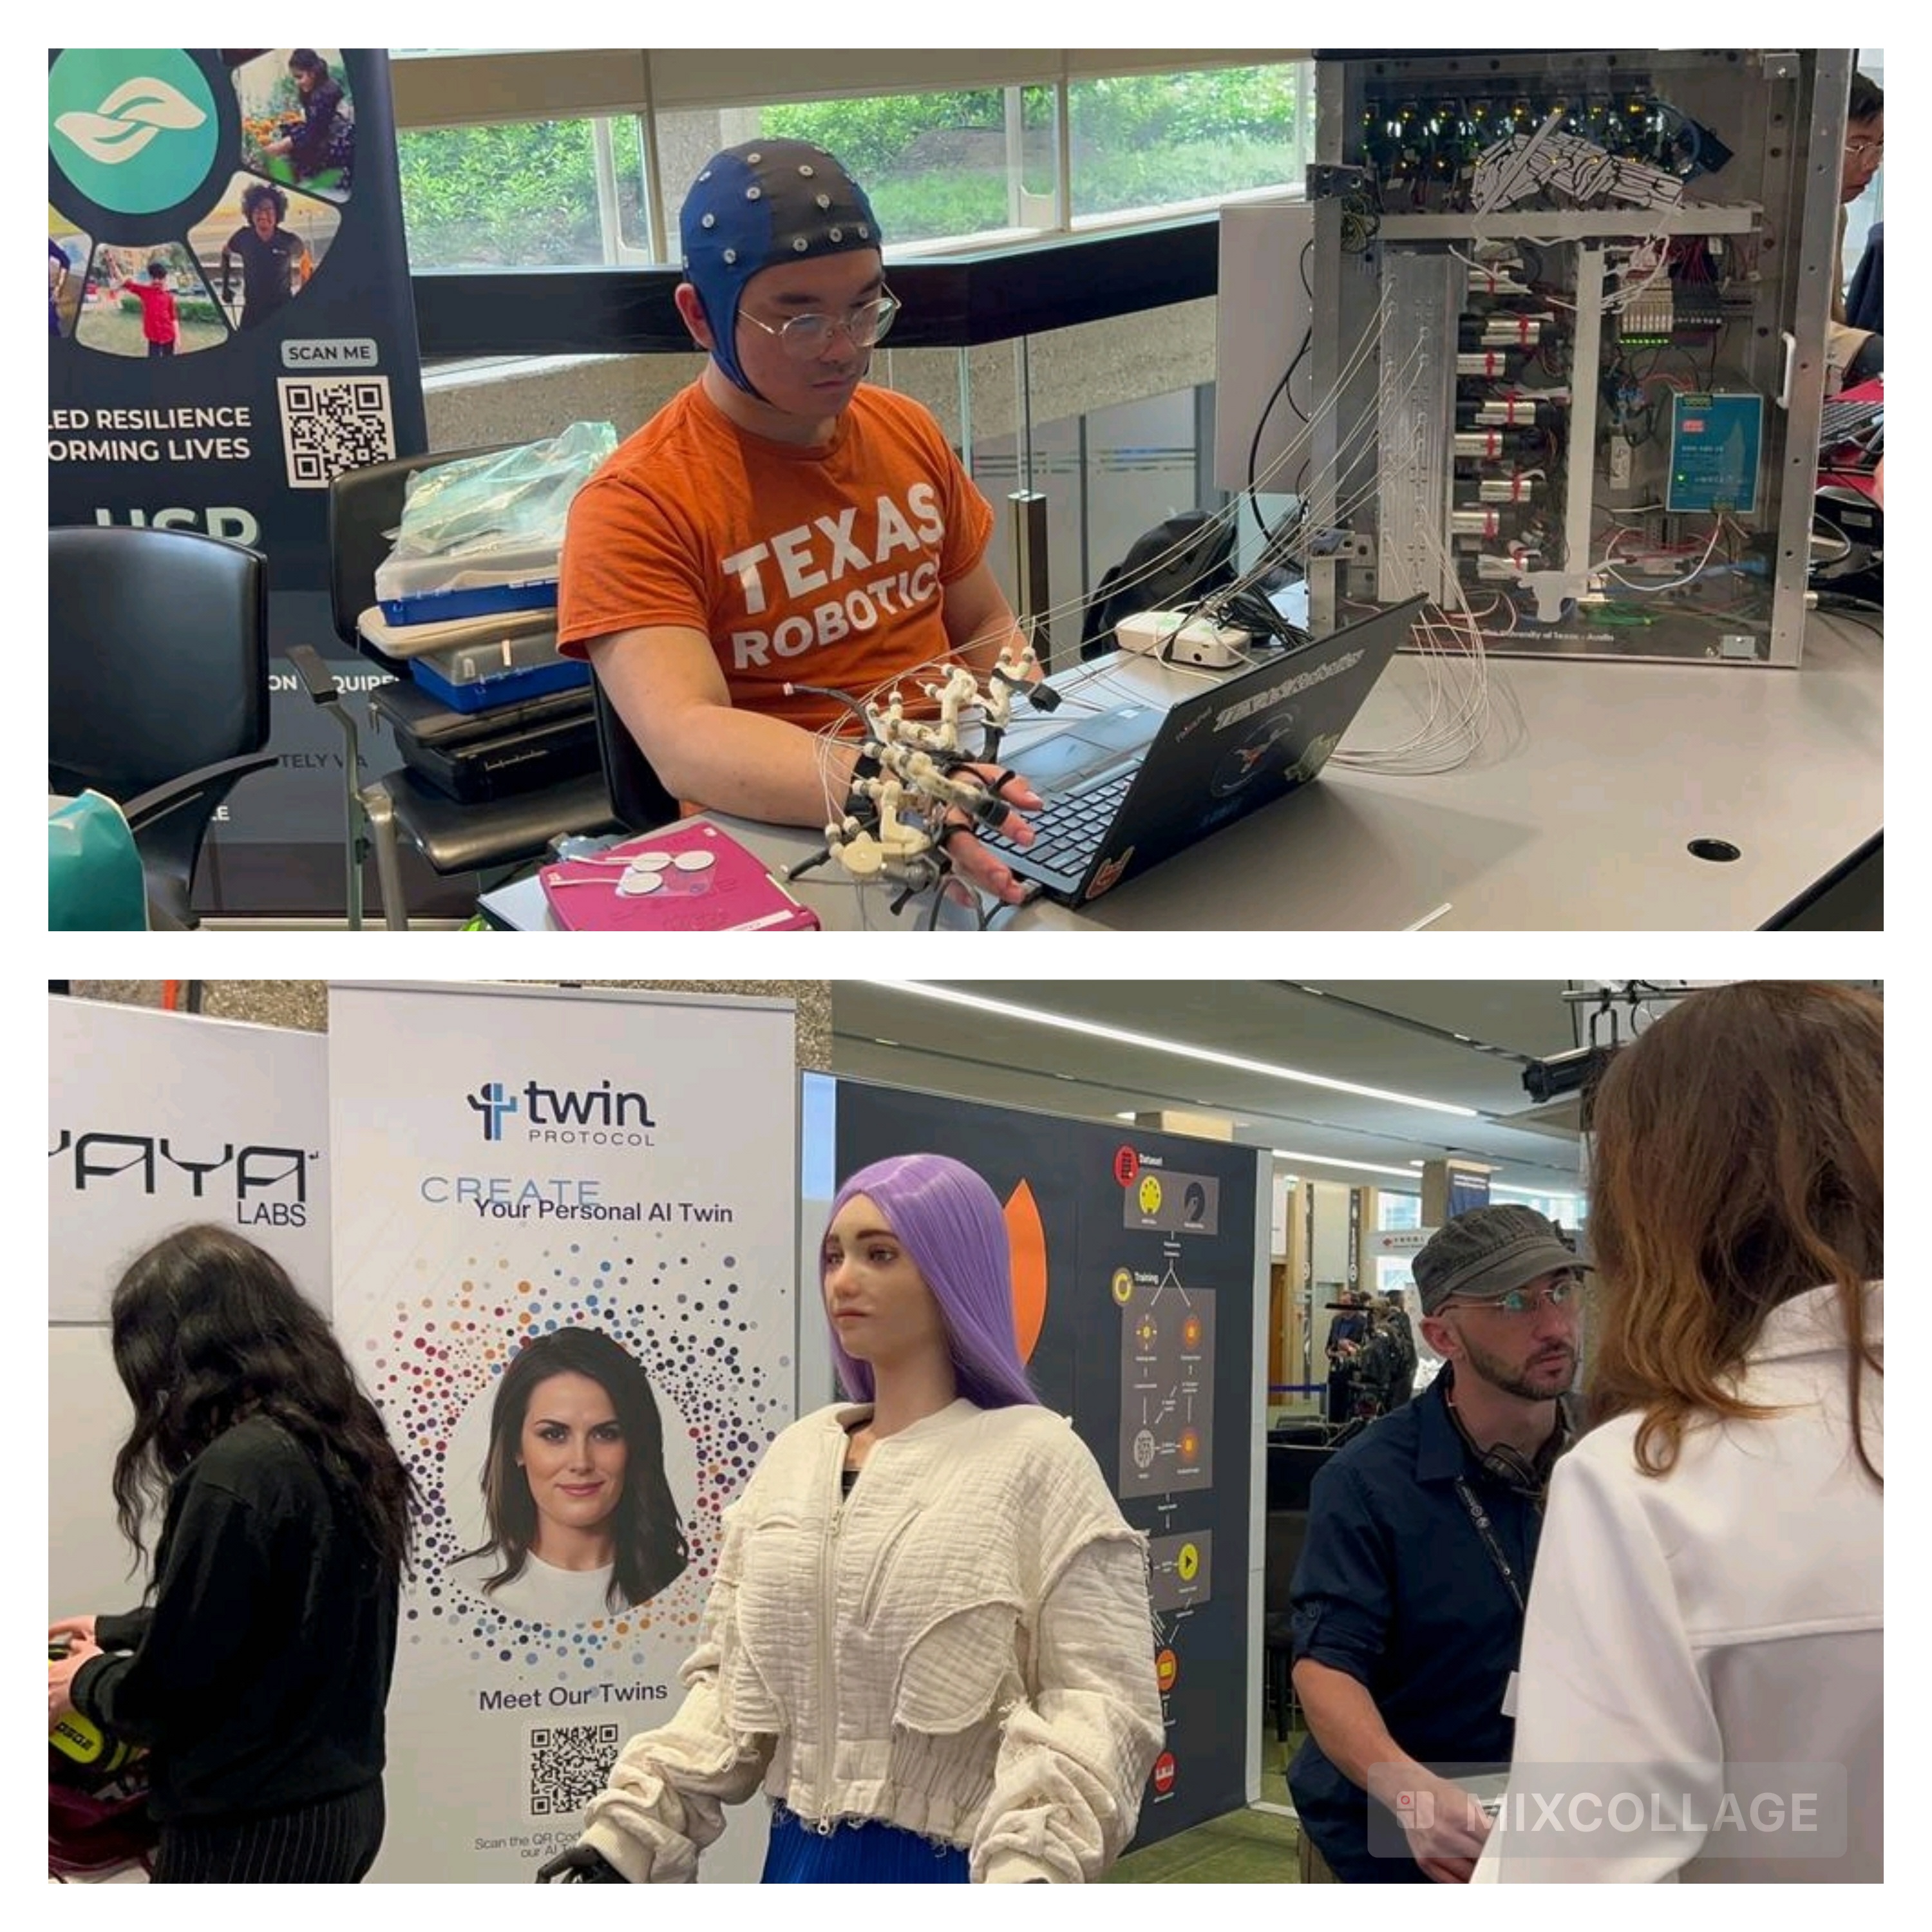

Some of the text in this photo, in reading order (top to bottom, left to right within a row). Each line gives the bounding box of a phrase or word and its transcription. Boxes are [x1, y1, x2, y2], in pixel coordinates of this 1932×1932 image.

[289, 345, 372, 361] SCAN ME
[96, 406, 251, 430] RESILIENCE
[48, 438, 251, 462] ORMING LIVES
[721, 482, 945, 615] TEXAS
[732, 560, 938, 670] ROBOTIC
[523, 1079, 656, 1128] twin
[528, 1129, 656, 1147] PROTOCOL
[421, 1176, 601, 1208] CREATE
[237, 1202, 307, 1227] LABS
[474, 1198, 734, 1223] Your Personal AI Twin
[479, 1681, 668, 1710] Meet Our Twins
[474, 1837, 507, 1850] Scan
[509, 1836, 529, 1847] the
[532, 1832, 553, 1845] QR
[520, 1848, 540, 1858] our
